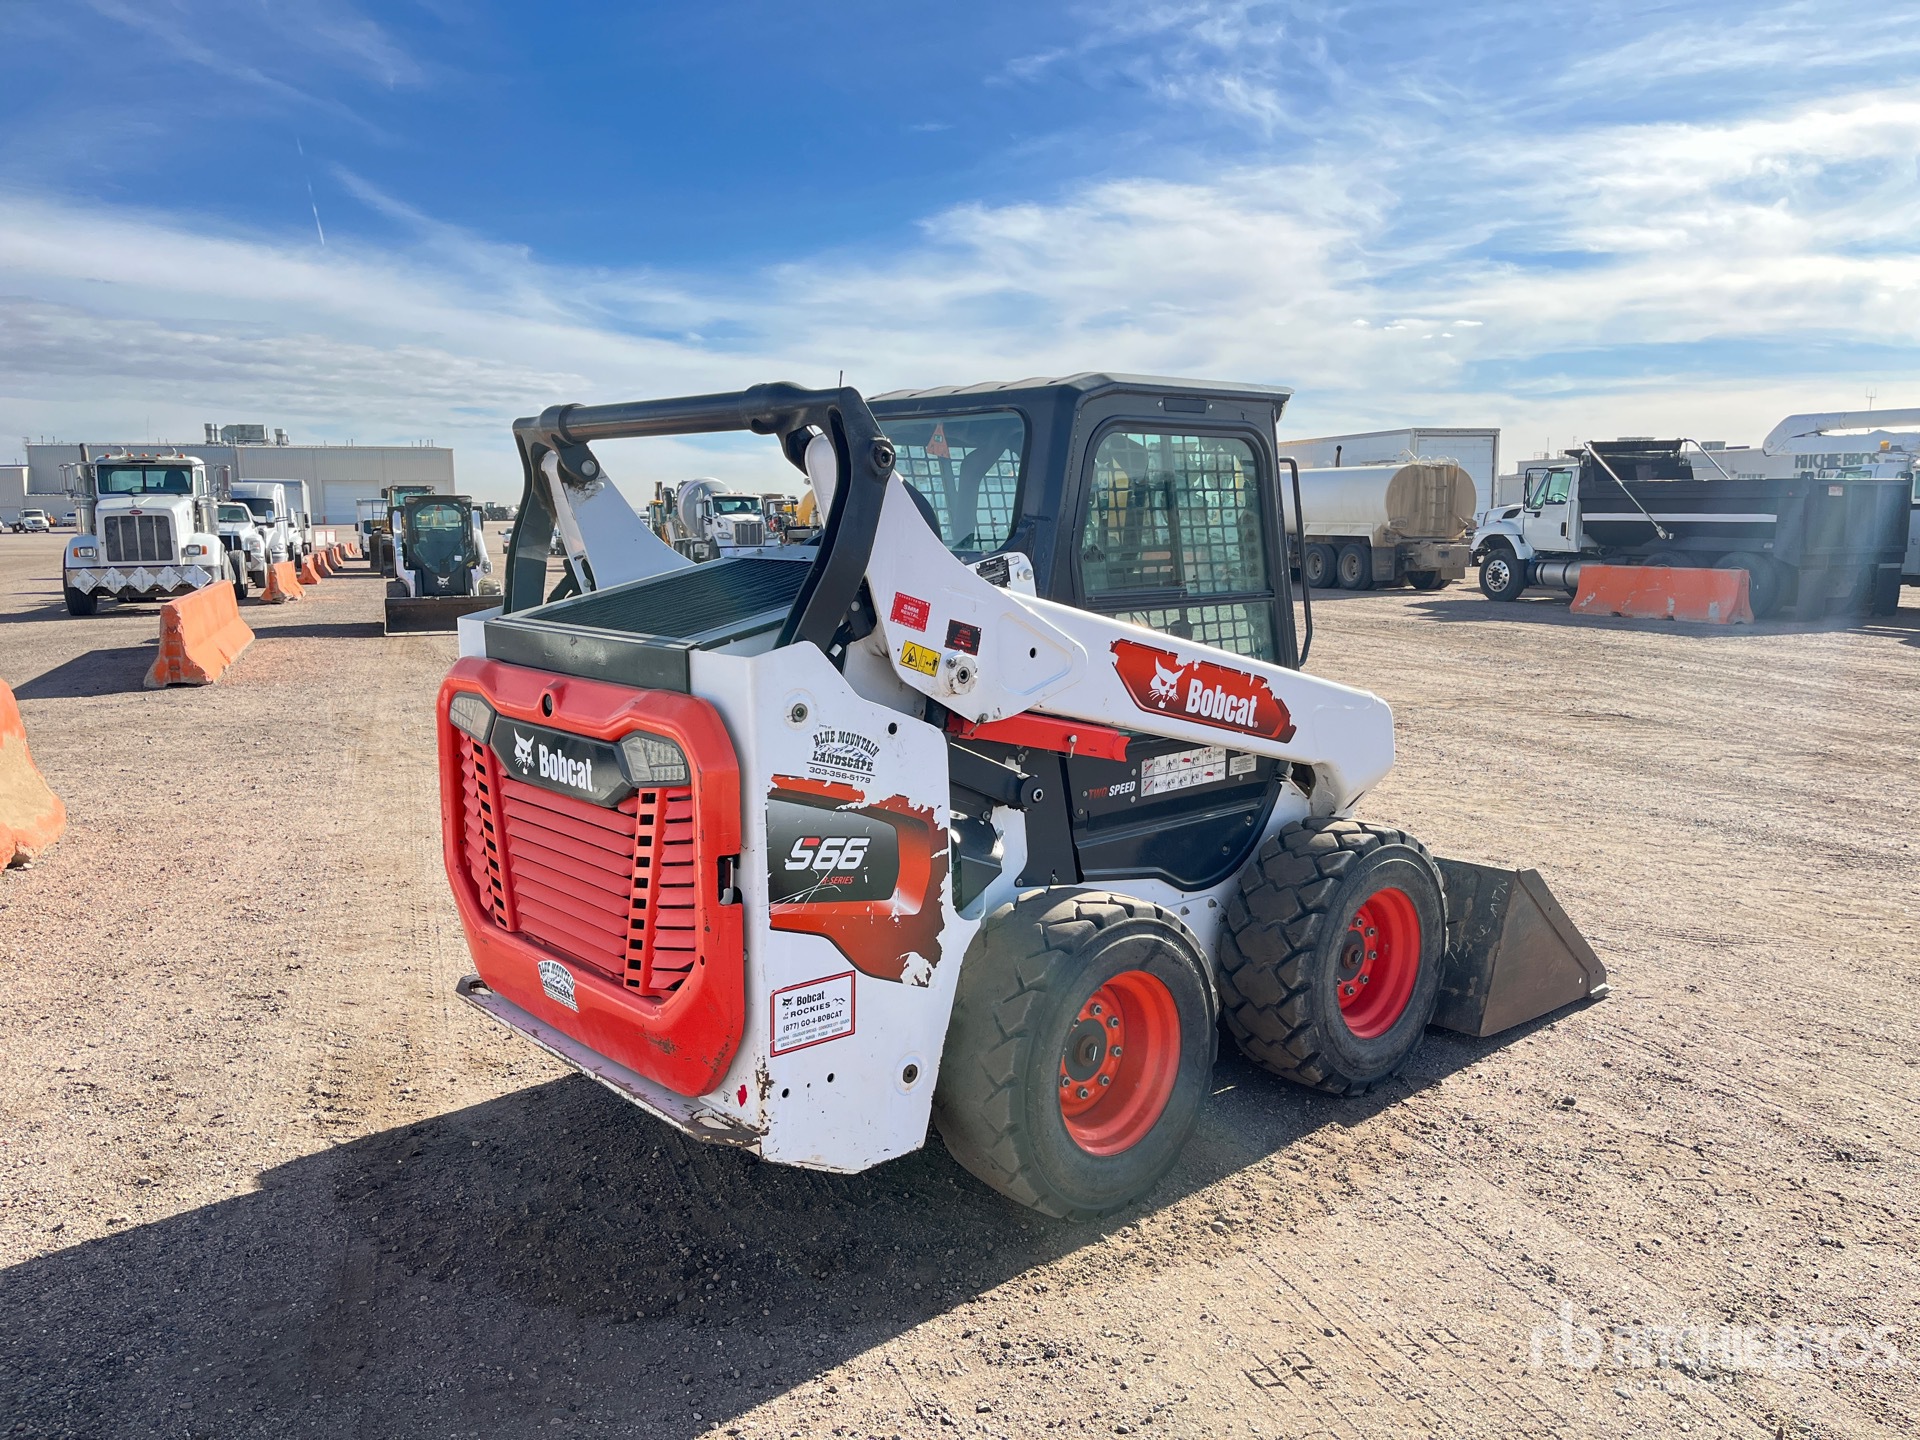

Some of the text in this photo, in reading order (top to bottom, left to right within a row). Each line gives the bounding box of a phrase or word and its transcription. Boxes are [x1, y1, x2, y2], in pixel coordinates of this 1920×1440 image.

[1185, 678, 1257, 728] Bobcat
[813, 730, 880, 758] BLUE MOUNTAIN
[538, 743, 593, 792] Bobcat
[812, 751, 874, 772] LANDSCAPE
[809, 766, 871, 784] 303-356-5179
[1088, 780, 1136, 800] TWO SPEED
[784, 837, 871, 871] S66
[796, 990, 825, 1006] Bobcat
[790, 1001, 831, 1018] ROCKIES
[783, 1022, 800, 1033] (877)
[800, 1010, 843, 1027] GO-4-BOBCAT
